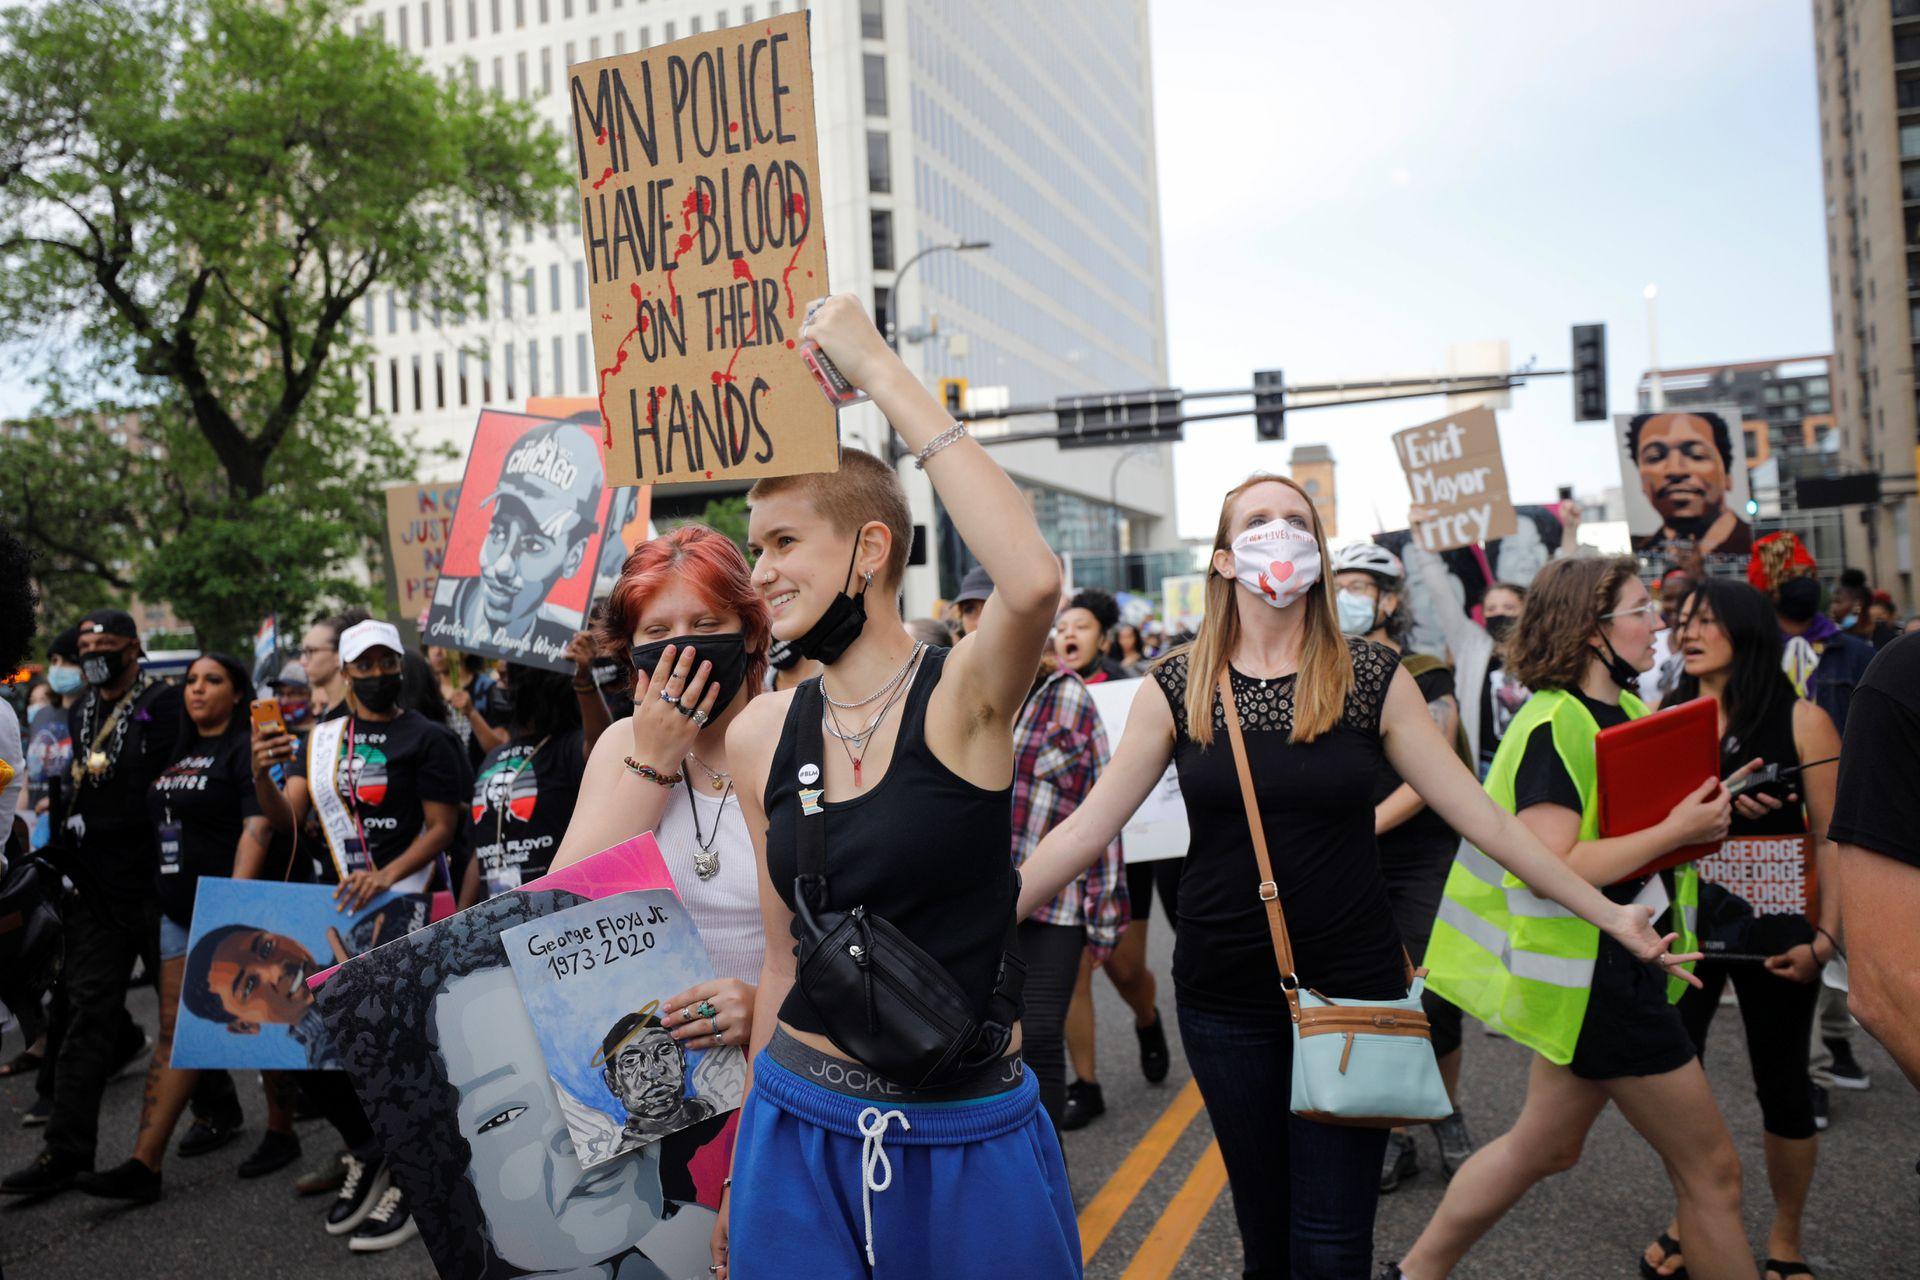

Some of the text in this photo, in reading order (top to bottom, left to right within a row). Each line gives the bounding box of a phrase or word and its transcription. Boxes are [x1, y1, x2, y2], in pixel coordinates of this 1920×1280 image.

[572, 33, 796, 180] MN POLICE
[585, 159, 811, 284] HAVE BLOOD
[637, 277, 784, 363] ON THEIR
[630, 377, 774, 479] HANDS
[1404, 422, 1467, 469] Evict
[506, 447, 577, 490] CHICAGO
[1411, 467, 1491, 504] Mayor
[800, 769, 819, 777] #BLM
[527, 905, 669, 956] George Floyd Jr.
[547, 931, 656, 980] 1973-2020
[810, 1060, 903, 1095] JOCKE
